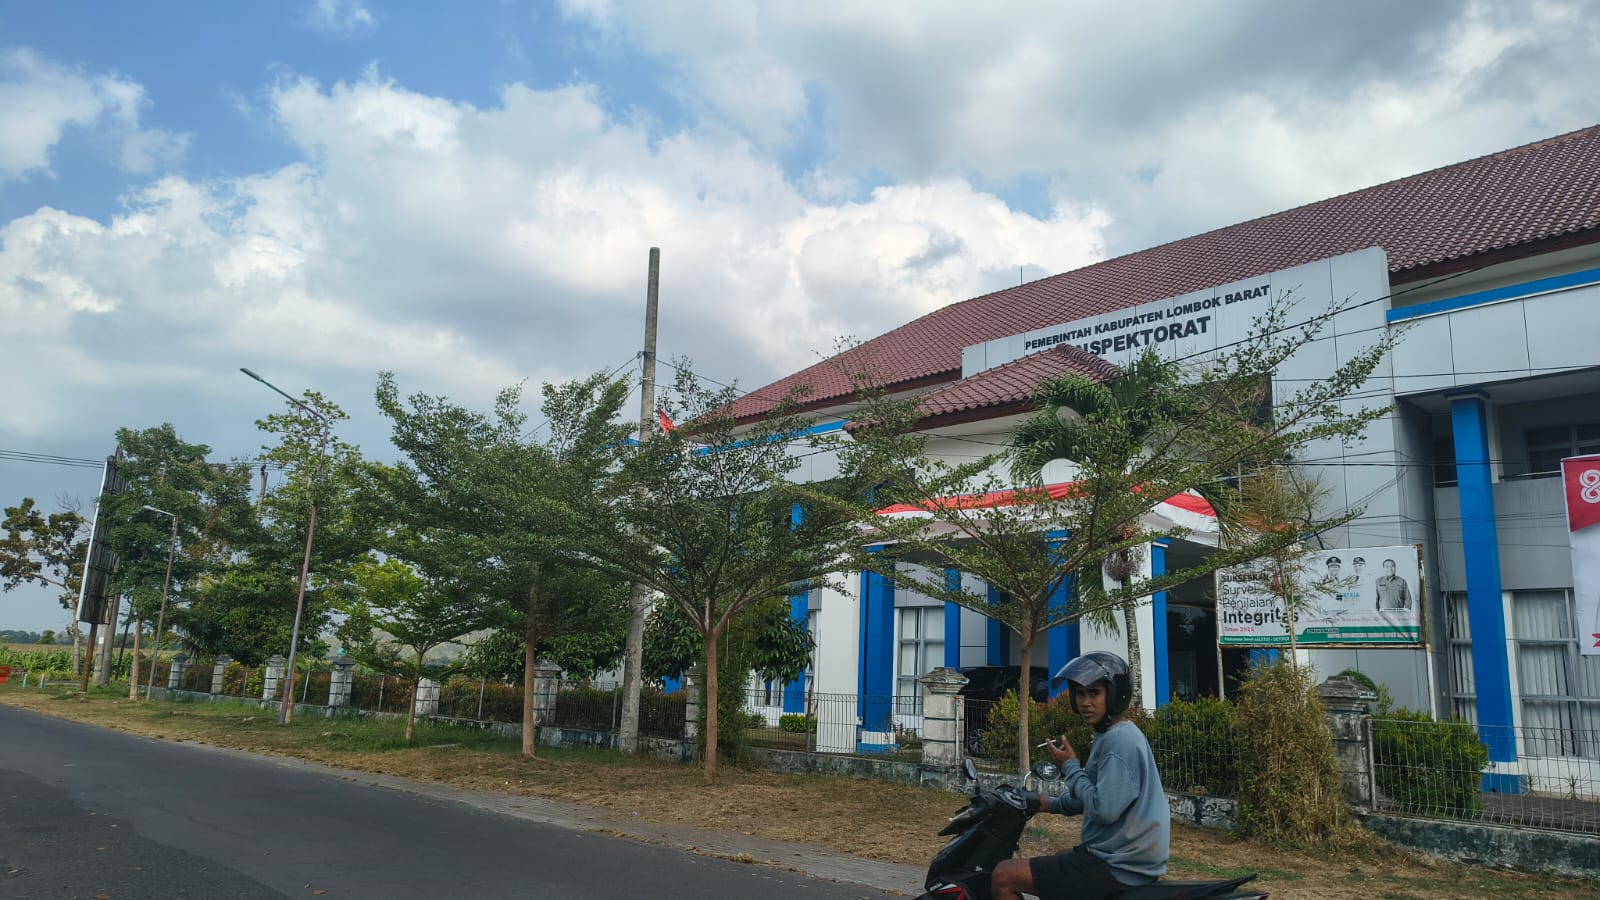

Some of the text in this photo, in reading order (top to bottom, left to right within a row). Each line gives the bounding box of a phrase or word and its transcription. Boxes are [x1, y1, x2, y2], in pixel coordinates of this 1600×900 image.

[1025, 284, 1270, 350] PEMERINTAH KABUPATEN LOMBOK BARAT
[1076, 316, 1211, 355] SPEKTORAT
[1223, 607, 1299, 626] Integritas
